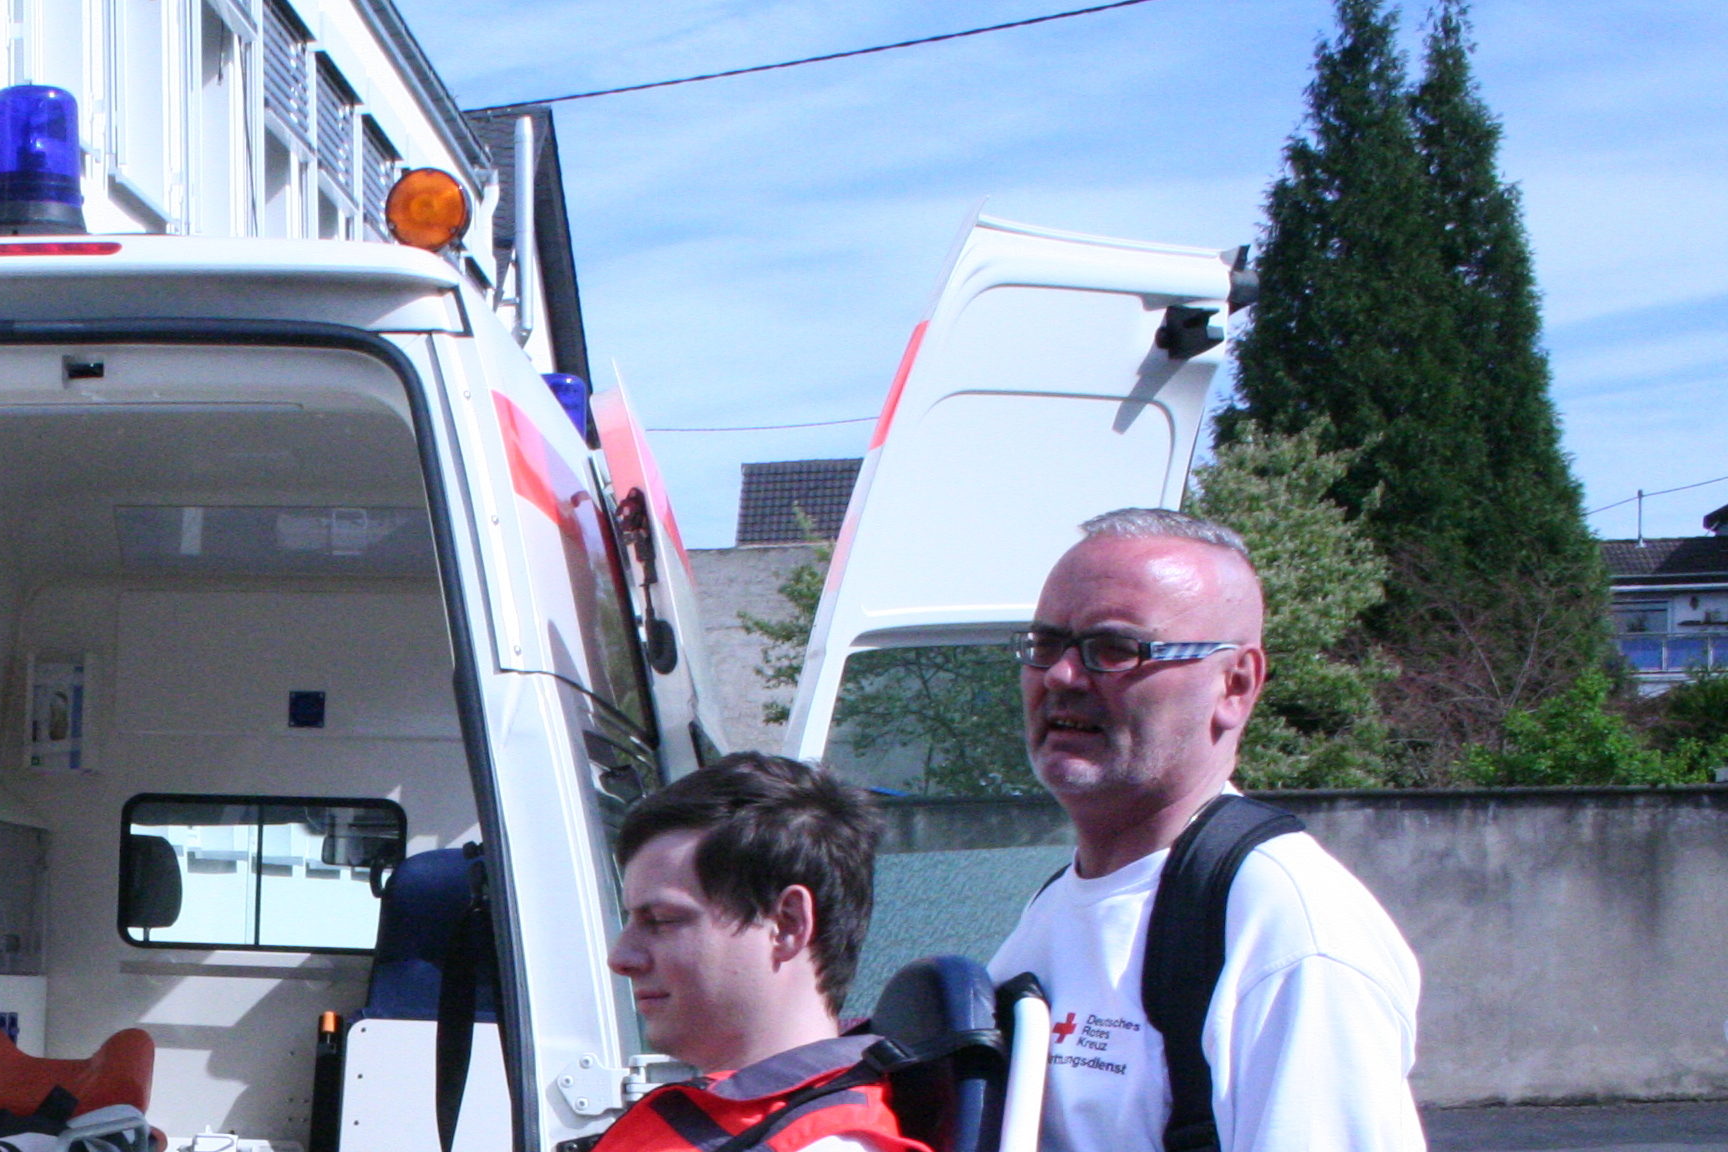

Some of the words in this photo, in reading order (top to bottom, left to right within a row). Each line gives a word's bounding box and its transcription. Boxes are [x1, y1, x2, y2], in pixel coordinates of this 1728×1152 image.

[1086, 1014, 1141, 1032] Deutsches
[1081, 1026, 1110, 1040] Rotes
[1076, 1037, 1108, 1051] Kreuz
